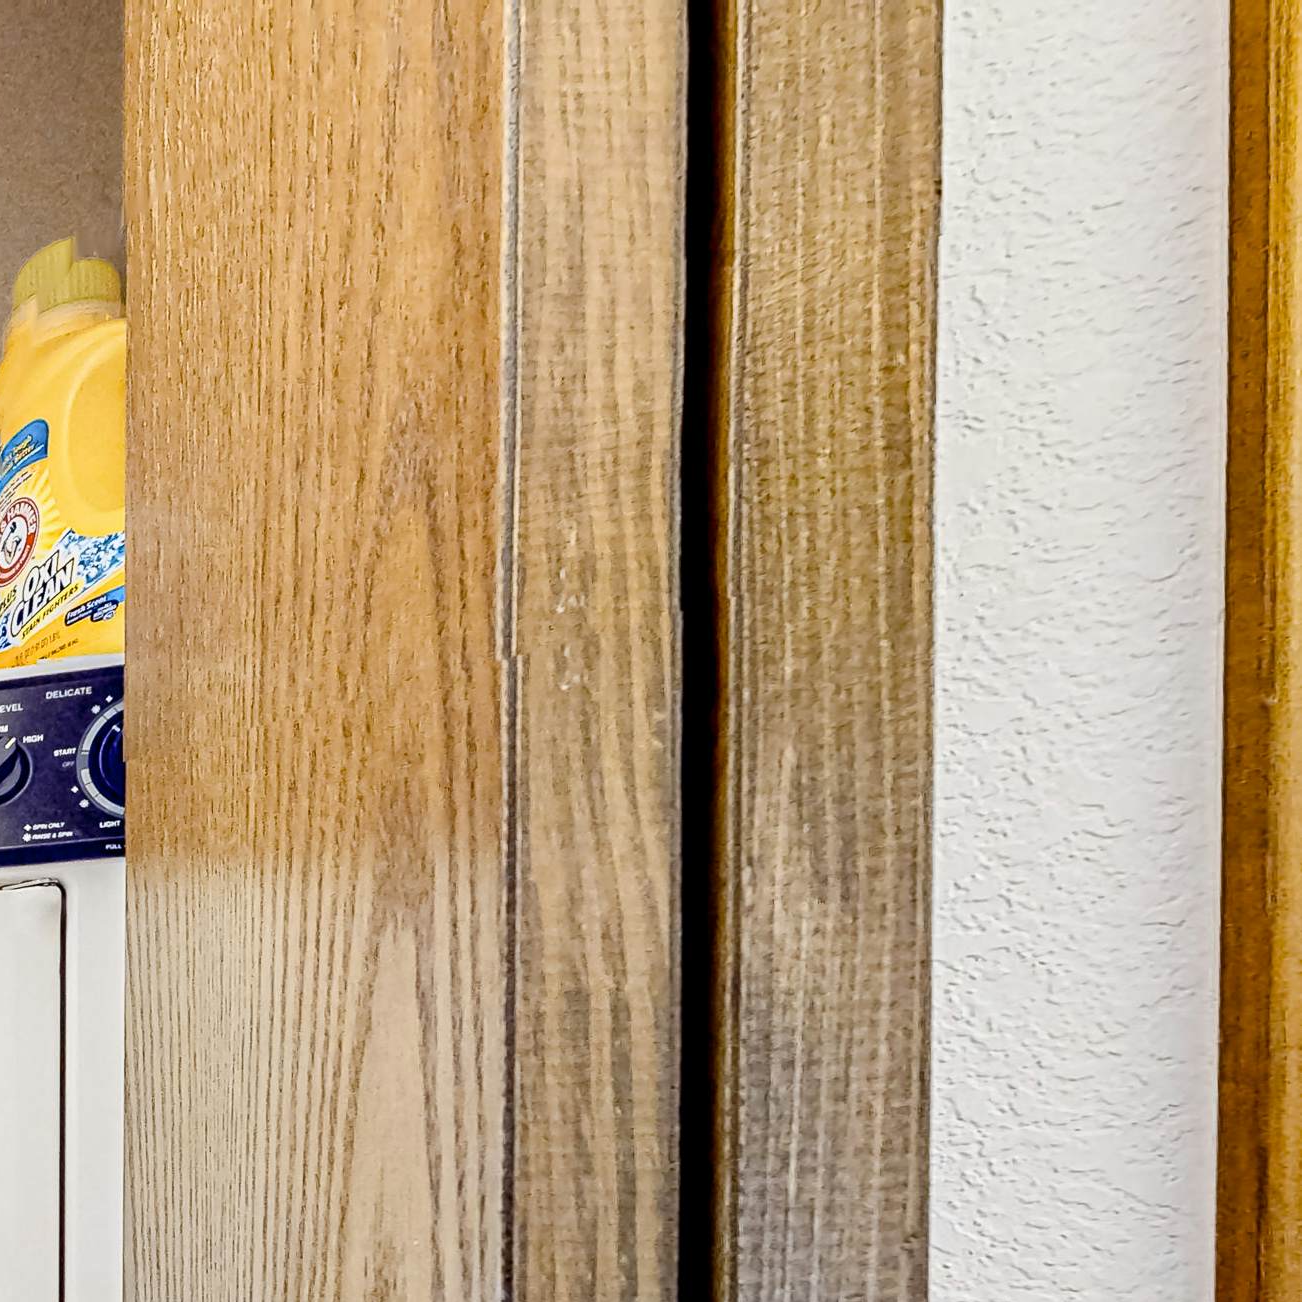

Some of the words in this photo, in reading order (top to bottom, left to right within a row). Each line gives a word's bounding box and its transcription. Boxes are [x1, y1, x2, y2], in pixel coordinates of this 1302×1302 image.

[23, 550, 59, 602] OXI
[11, 557, 74, 637] CLEAN
[46, 686, 93, 700] DELICATE
[22, 734, 45, 744] HIGH
[53, 747, 77, 758] START
[99, 820, 121, 829] LIGHT
